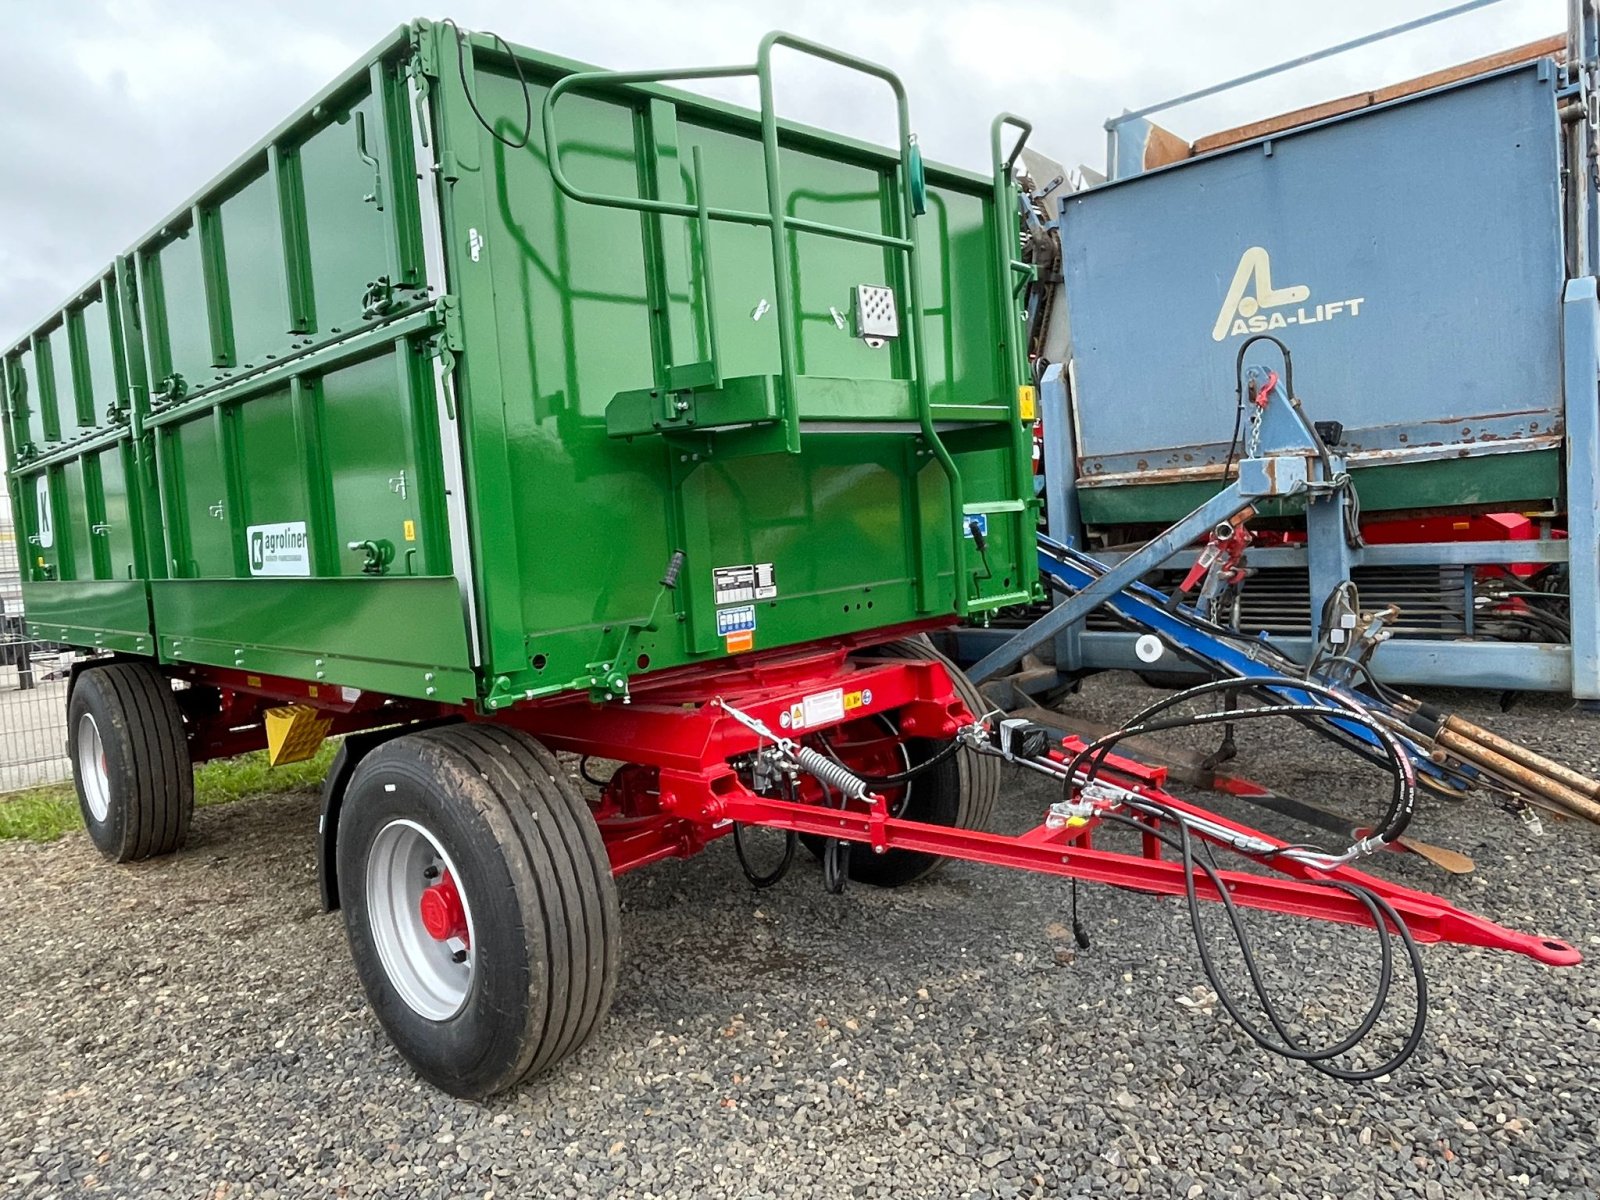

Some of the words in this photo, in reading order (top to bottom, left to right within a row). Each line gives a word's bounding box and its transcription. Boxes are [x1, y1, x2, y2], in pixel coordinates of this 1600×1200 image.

[1230, 297, 1365, 337] ASA-LIFT
[40, 490, 50, 532] K
[265, 526, 307, 554] agroliner
